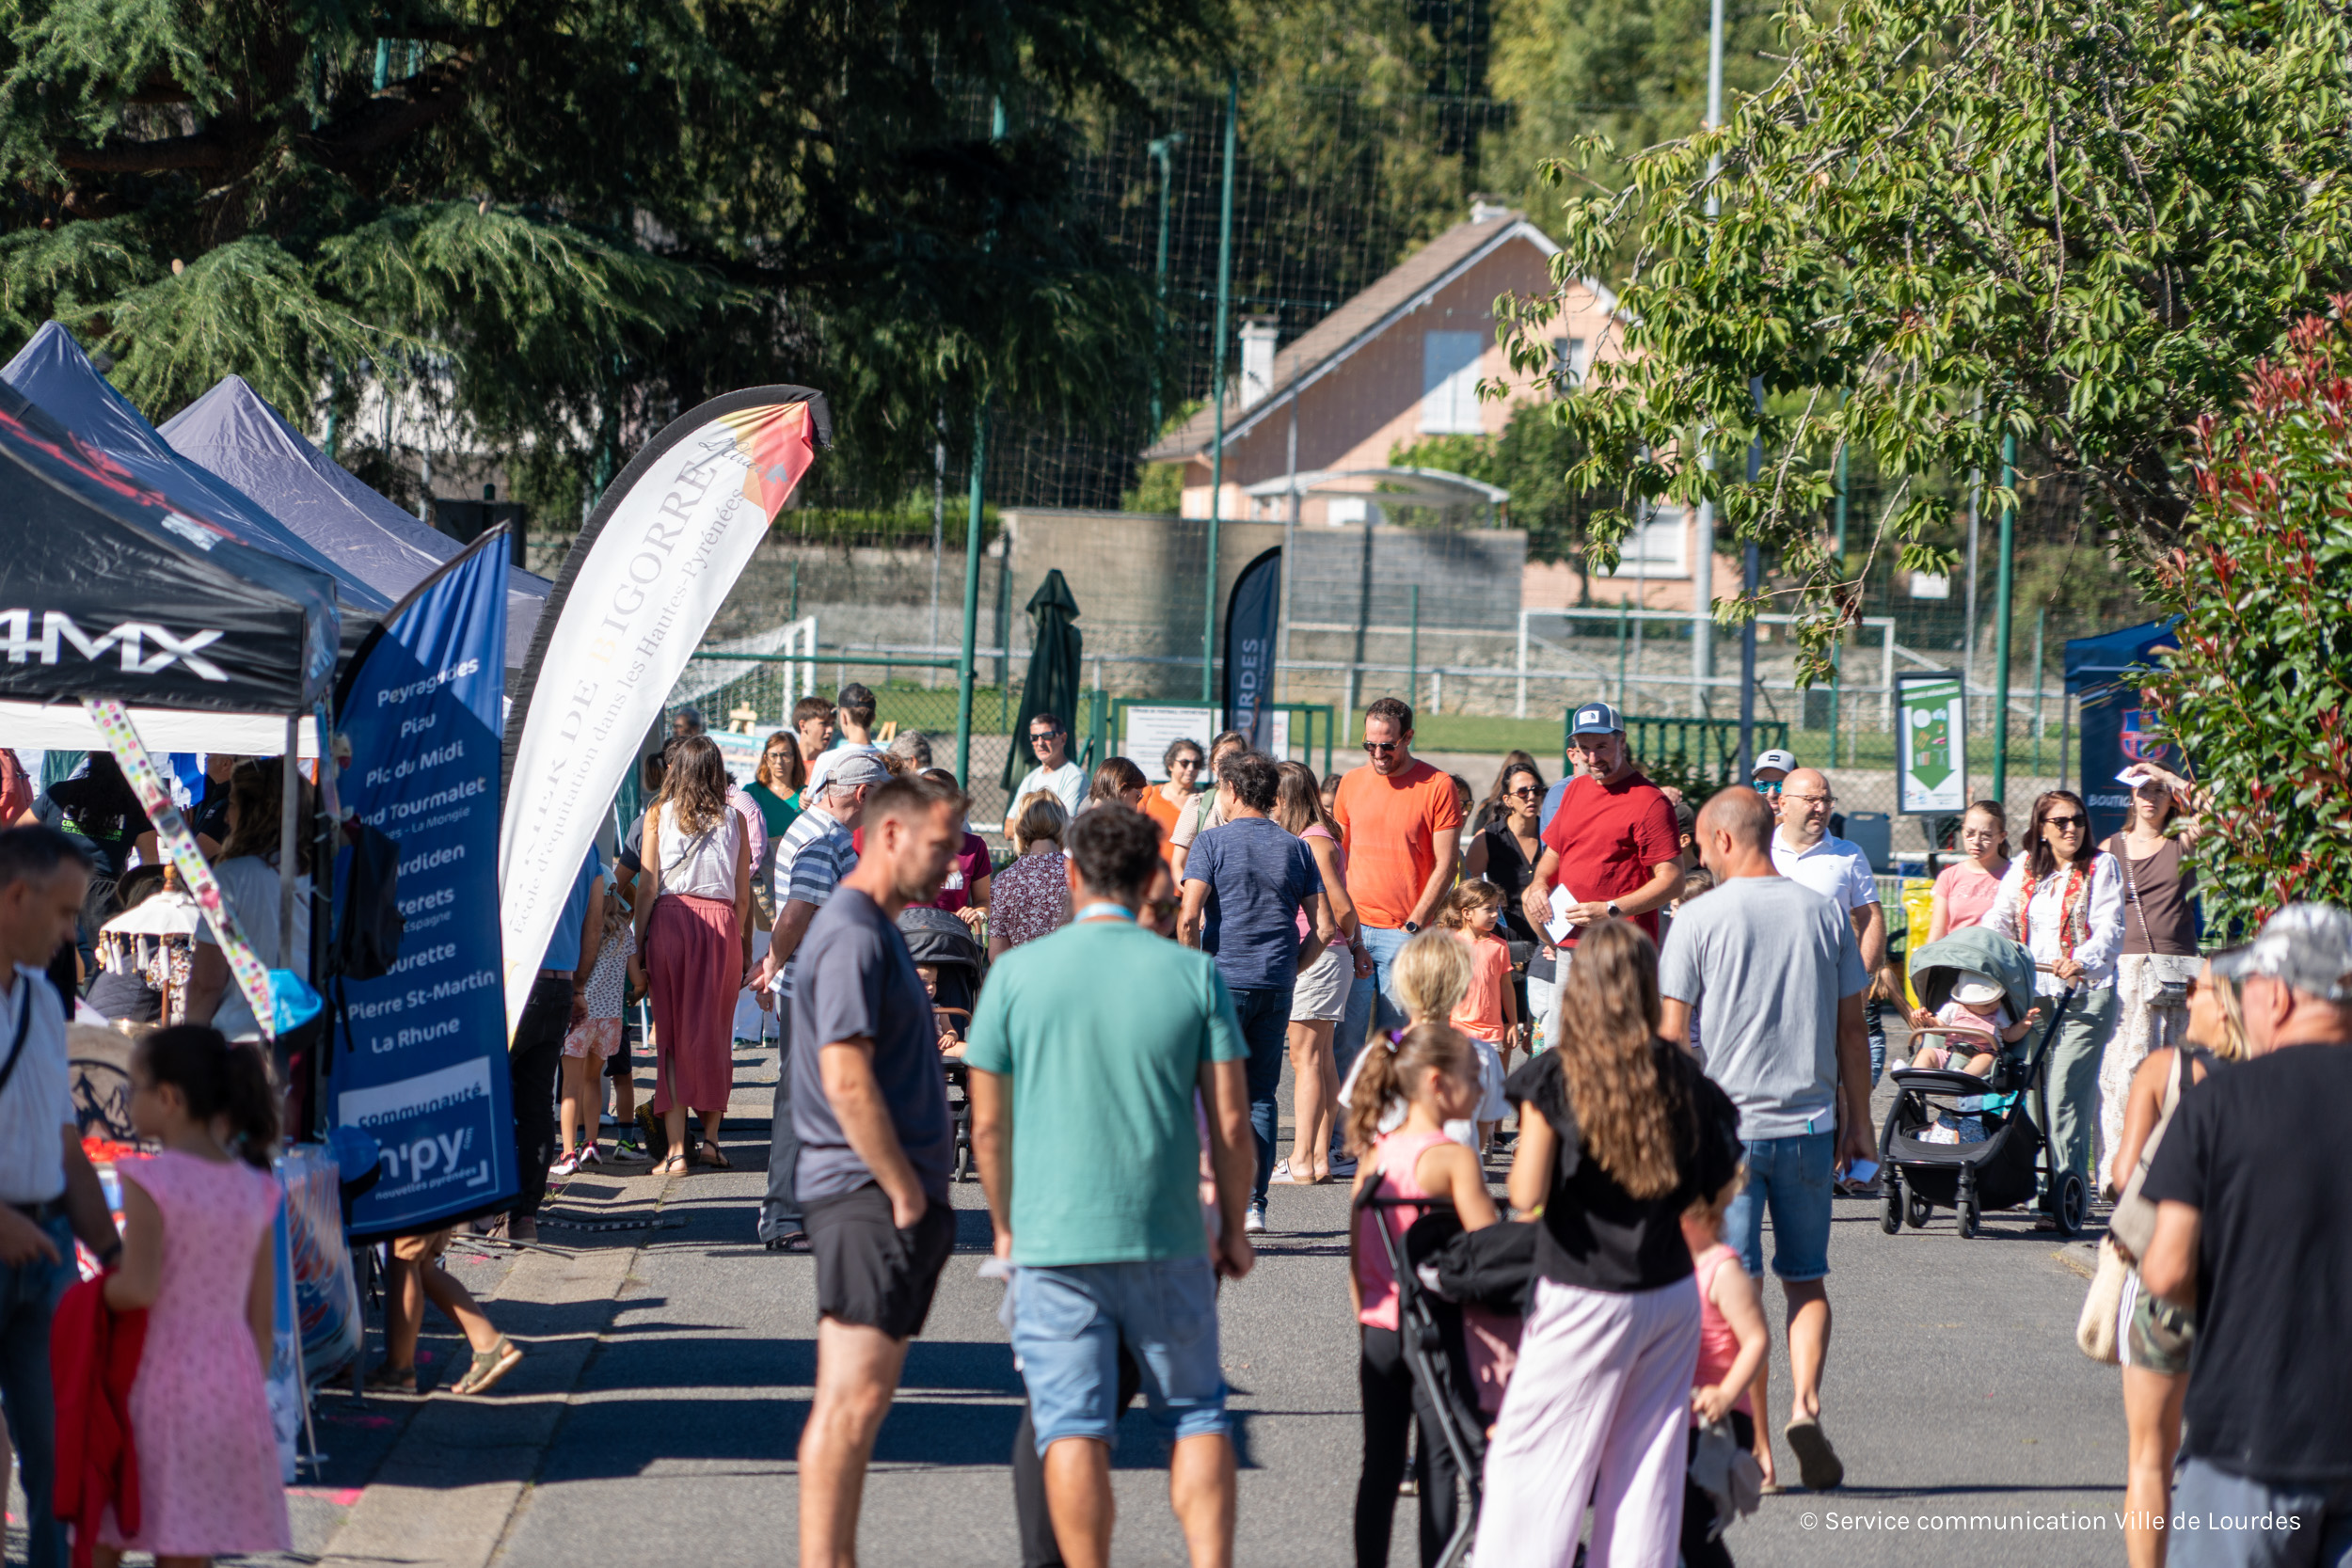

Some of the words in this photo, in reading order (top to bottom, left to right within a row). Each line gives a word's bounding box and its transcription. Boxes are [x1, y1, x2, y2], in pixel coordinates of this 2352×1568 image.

[593, 689, 628, 744] dans
[618, 660, 646, 698] les
[636, 487, 747, 659] Hautes-Pyrénées
[377, 657, 480, 707] Peyragudes
[401, 713, 437, 738] Piau
[561, 679, 600, 745] DE
[366, 769, 391, 788] Pic
[394, 760, 416, 779] du
[420, 739, 464, 770] Midi
[389, 776, 486, 820] Tourmalet
[411, 822, 425, 833] La
[425, 806, 471, 829] Mongie
[397, 888, 455, 916] terets
[348, 996, 403, 1022] Pierre
[406, 970, 496, 1009] St-Martin
[371, 1036, 394, 1054] La
[398, 1018, 461, 1048] Rhune
[358, 1082, 483, 1128] communauté
